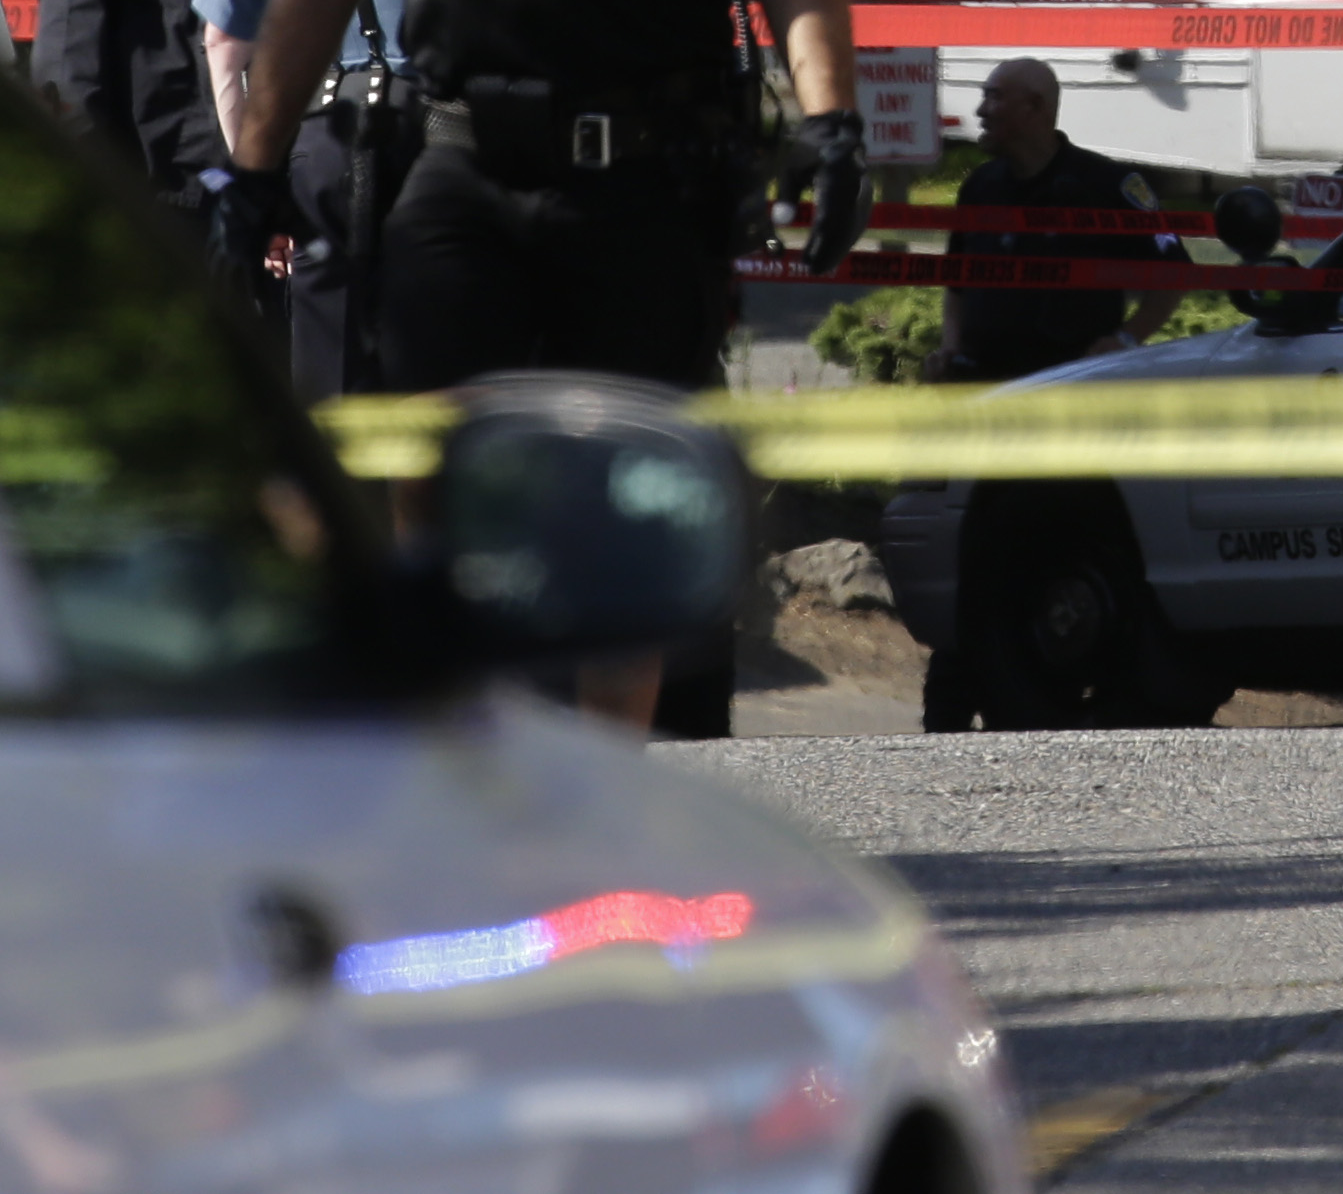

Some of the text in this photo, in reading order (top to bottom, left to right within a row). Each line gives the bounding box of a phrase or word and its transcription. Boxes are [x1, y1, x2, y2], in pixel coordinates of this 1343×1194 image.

[857, 62, 932, 84] PARKING
[875, 92, 911, 112] ANY
[872, 121, 917, 143] TIME
[1301, 180, 1341, 206] NO
[1218, 528, 1317, 562] CAMPUS
